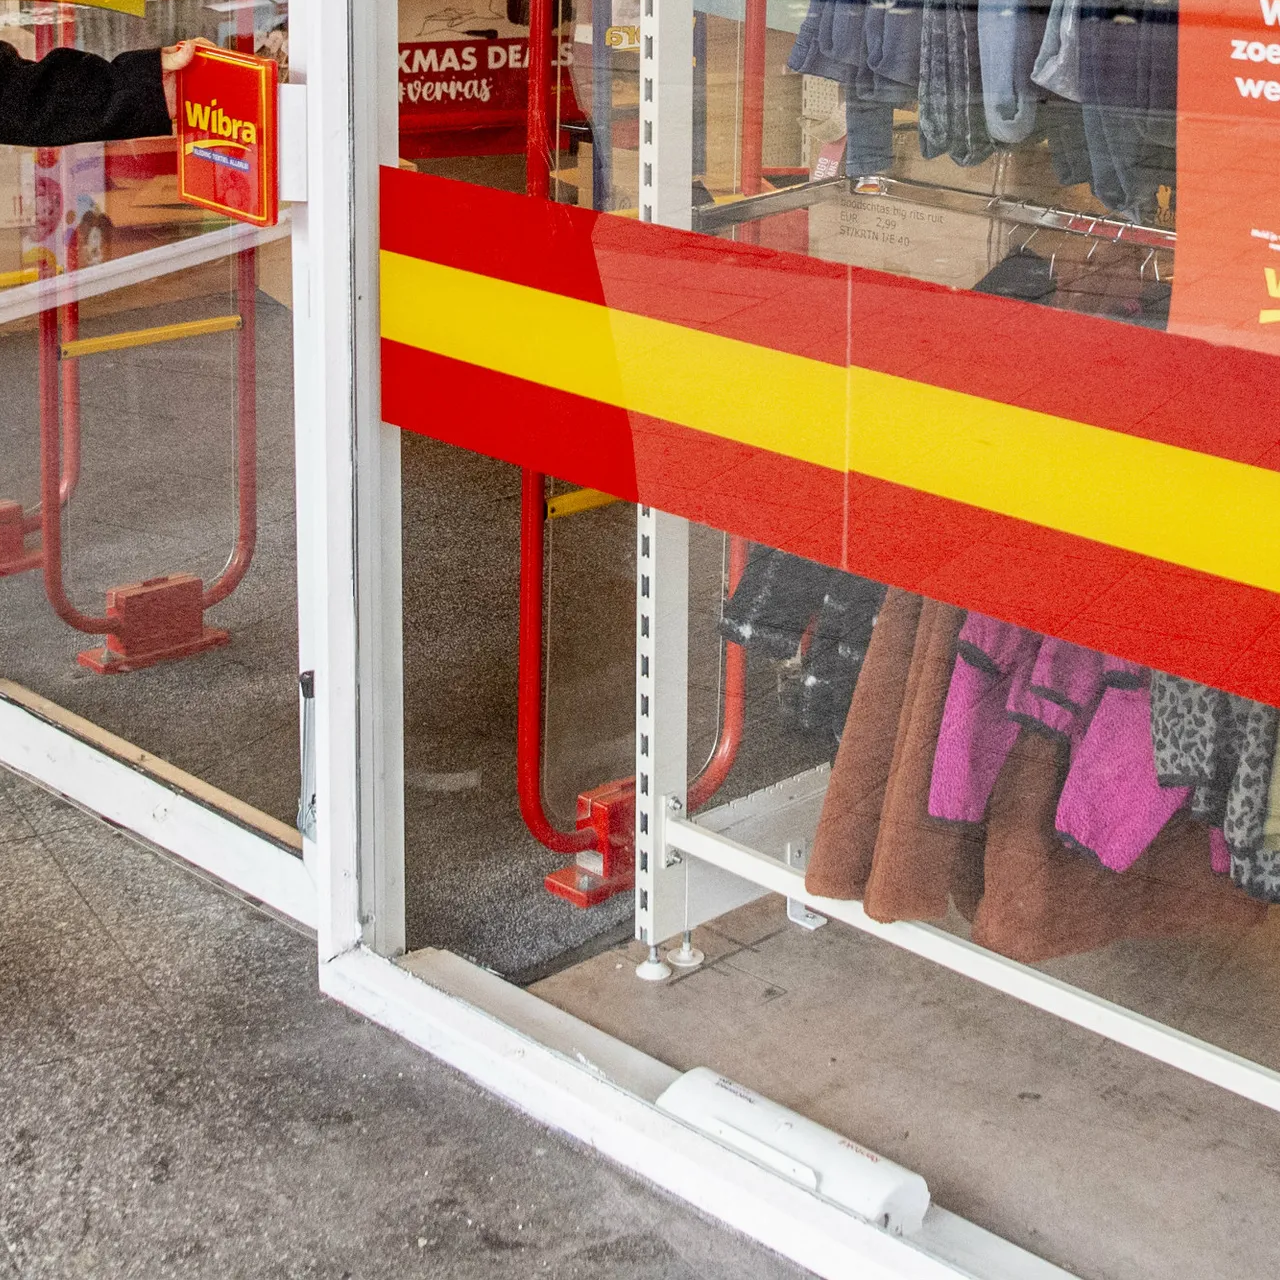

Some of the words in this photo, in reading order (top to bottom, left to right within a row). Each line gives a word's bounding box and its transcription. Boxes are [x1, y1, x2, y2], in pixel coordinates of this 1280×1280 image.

[185, 99, 256, 144] Wibra
[840, 211, 858, 223] EUR
[876, 217, 897, 230] 2,99
